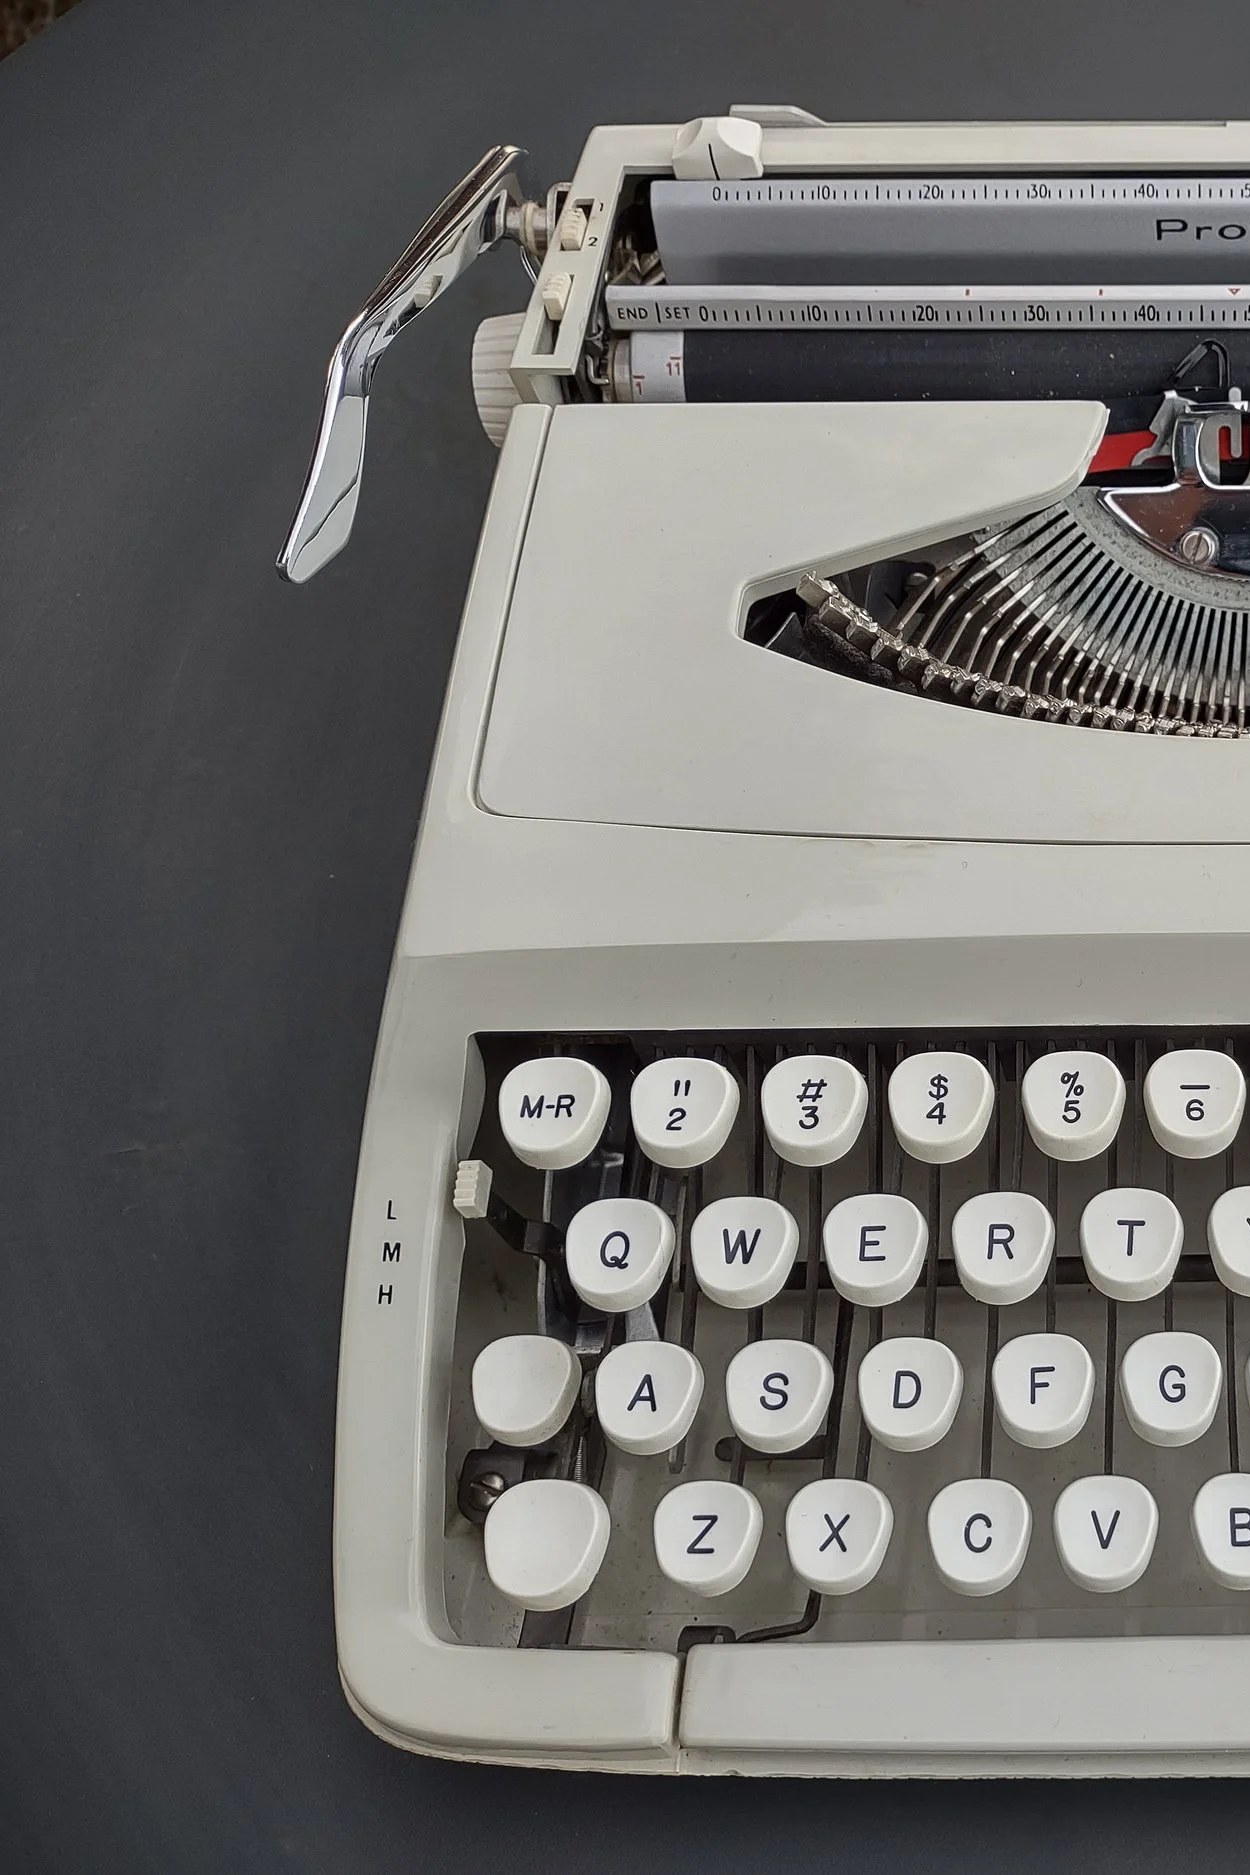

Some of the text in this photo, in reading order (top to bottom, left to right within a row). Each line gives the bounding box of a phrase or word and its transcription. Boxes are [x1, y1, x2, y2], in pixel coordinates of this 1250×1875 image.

[712, 185, 722, 201] 0
[817, 185, 831, 200] 10
[923, 184, 941, 200] 20
[1030, 183, 1048, 199] 30
[1138, 183, 1155, 199] 40
[587, 236, 599, 247] 2
[617, 307, 649, 320] END
[665, 306, 691, 320] SET
[699, 305, 709, 322] 0
[807, 305, 821, 322] 10
[916, 305, 934, 321] 20
[1027, 305, 1045, 321] 30
[1138, 304, 1156, 321] 40
[796, 1078, 828, 1102] #
[928, 1073, 949, 1101] $
[1060, 1070, 1085, 1099] %
[520, 1095, 575, 1118] M-R
[665, 1107, 687, 1131] 2
[798, 1105, 820, 1130] 3
[925, 1101, 947, 1125] 4
[1061, 1096, 1082, 1124] 5
[1185, 1098, 1205, 1122] 6
[377, 1199, 401, 1305] L M H
[599, 1230, 631, 1270] Q
[722, 1228, 762, 1265] W
[858, 1225, 887, 1262] E
[986, 1223, 1015, 1260] R
[1116, 1219, 1146, 1257] T
[626, 1373, 657, 1413] A
[759, 1372, 790, 1411] S
[892, 1370, 922, 1409] D
[1030, 1365, 1056, 1405] F
[1158, 1364, 1186, 1404] G
[686, 1514, 719, 1555] Z
[818, 1513, 851, 1553] X
[963, 1512, 993, 1554] C
[1090, 1509, 1121, 1550] V
